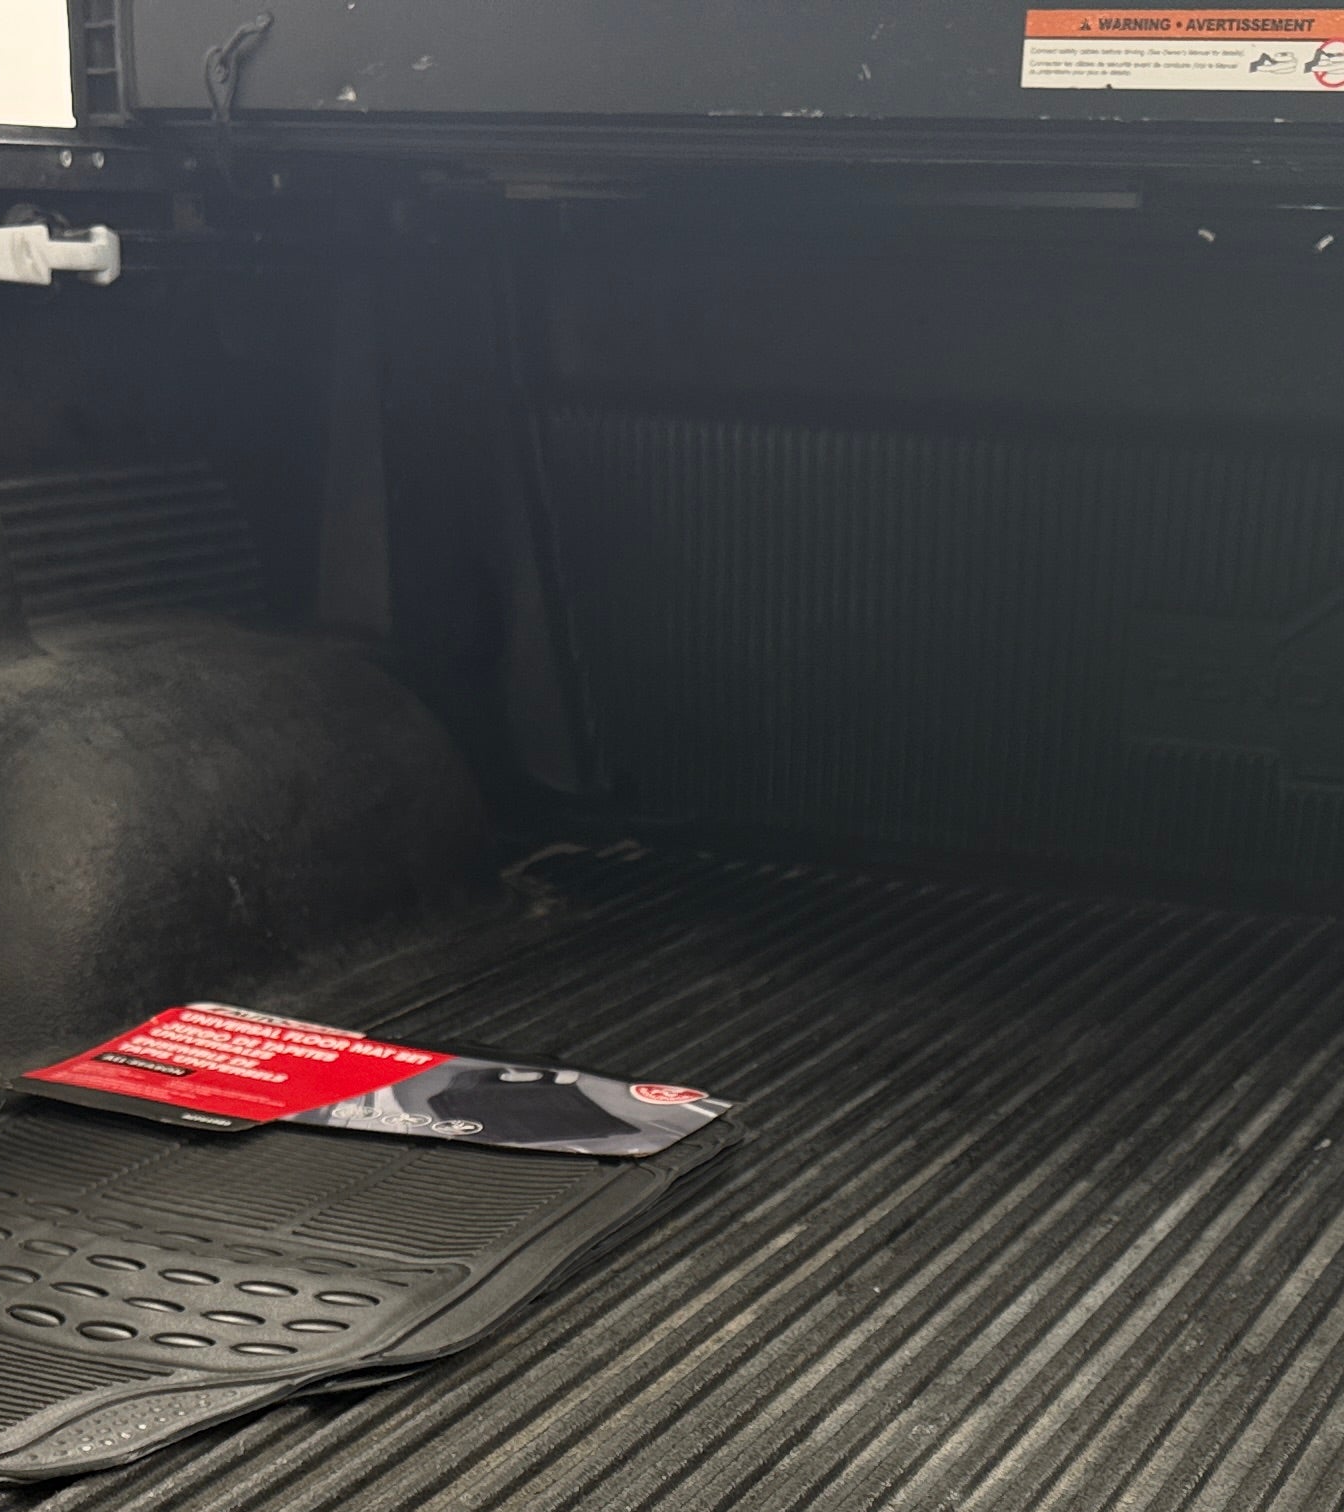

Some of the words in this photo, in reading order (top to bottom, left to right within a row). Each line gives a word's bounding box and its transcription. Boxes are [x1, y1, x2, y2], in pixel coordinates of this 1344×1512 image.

[1098, 17, 1171, 31] WARNING
[1185, 18, 1315, 32] AVERTISSEMENT
[179, 1010, 283, 1040] UNIVERSAL
[281, 1029, 351, 1052] FLOOR
[348, 1041, 397, 1060] MAT
